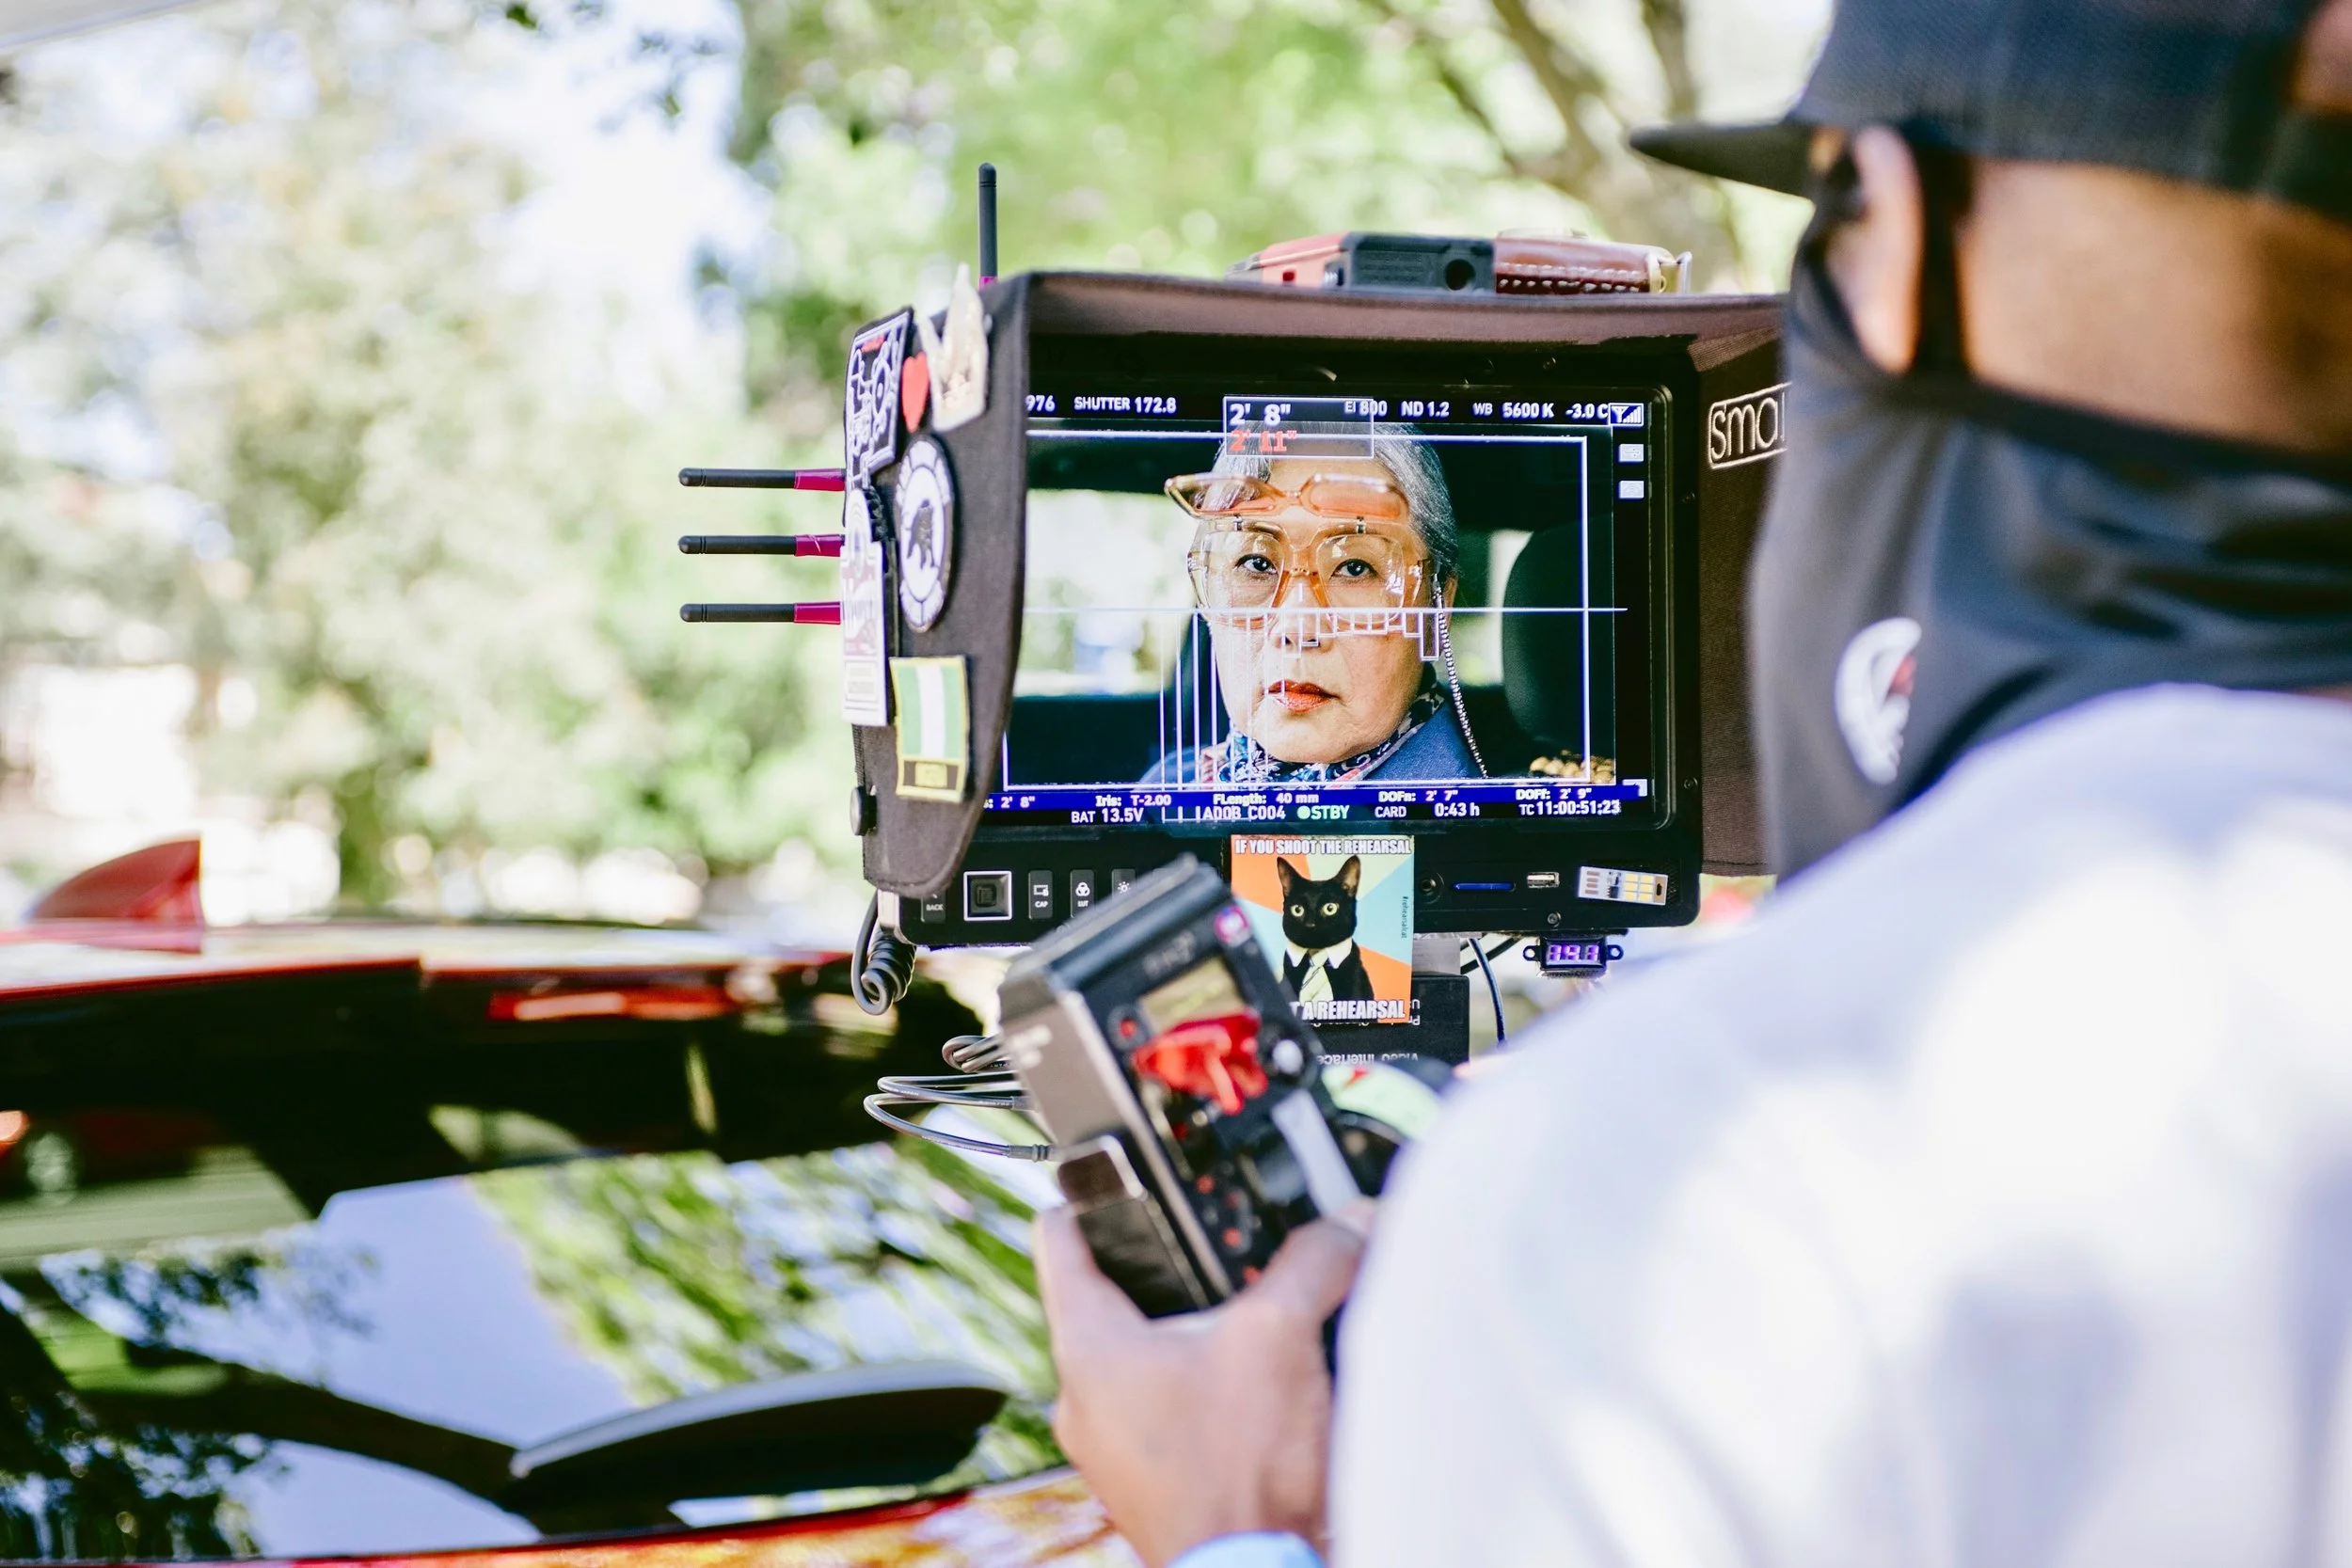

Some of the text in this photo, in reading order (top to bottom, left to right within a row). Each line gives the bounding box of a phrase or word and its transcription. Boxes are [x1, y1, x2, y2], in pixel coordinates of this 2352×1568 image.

[1074, 397, 1176, 413] SHUTTER 172.8
[1359, 400, 1387, 416] 800
[1401, 401, 1450, 417] ND 1.2
[1472, 402, 1554, 418] WB 5600 K
[1565, 404, 1595, 419] -3.0
[1095, 794, 1172, 807] Iris: T-2.00
[1276, 792, 1293, 804] 40
[1295, 794, 1319, 804] mm
[1071, 807, 1145, 823] BAT 13.5V
[1311, 805, 1350, 819] STBY
[1375, 802, 1481, 818] CARD 0:43 h
[1519, 803, 1535, 816] TC
[1235, 839, 1411, 855] IF YOU SHOOT THE REHEARSAL
[926, 903, 945, 912] BACK
[1035, 900, 1049, 909] CAP
[1302, 1002, 1315, 1020] A
[1317, 1000, 1406, 1020] REHEARSAL
